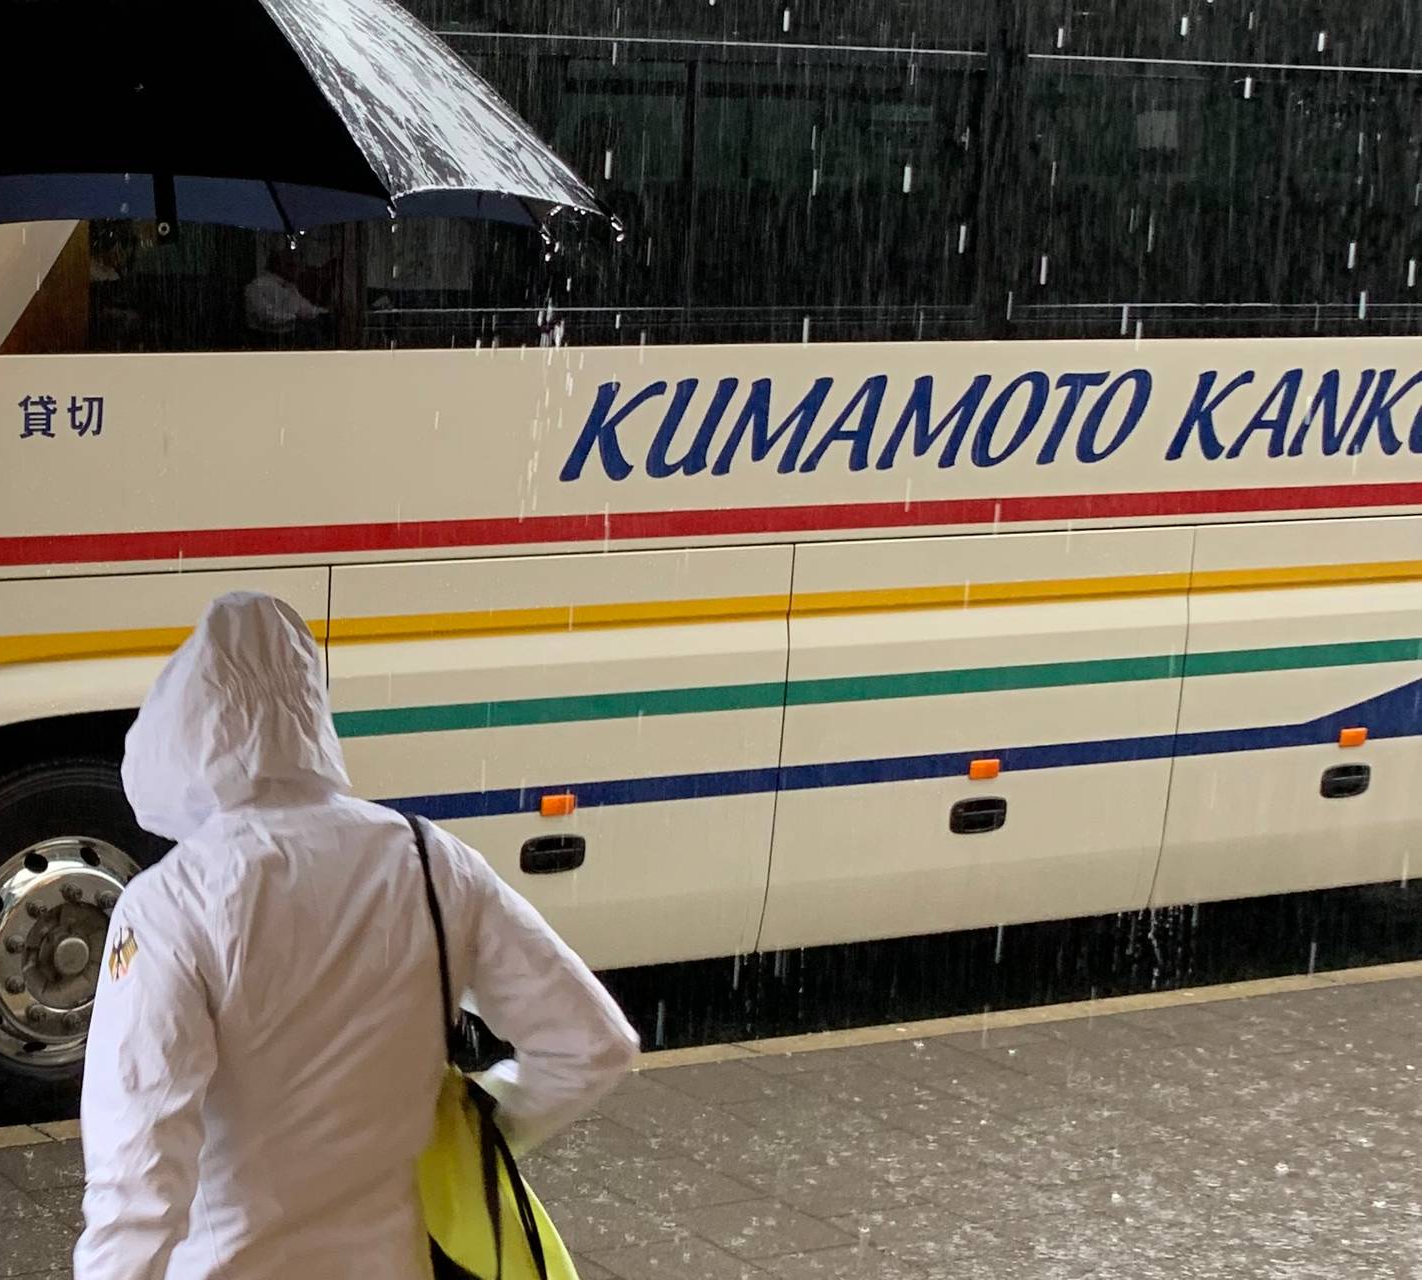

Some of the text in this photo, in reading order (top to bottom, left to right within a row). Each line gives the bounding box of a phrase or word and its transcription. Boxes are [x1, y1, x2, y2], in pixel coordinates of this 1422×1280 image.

[18, 395, 104, 439] 貸切
[558, 368, 1422, 482] KUMAMOTO KANK
